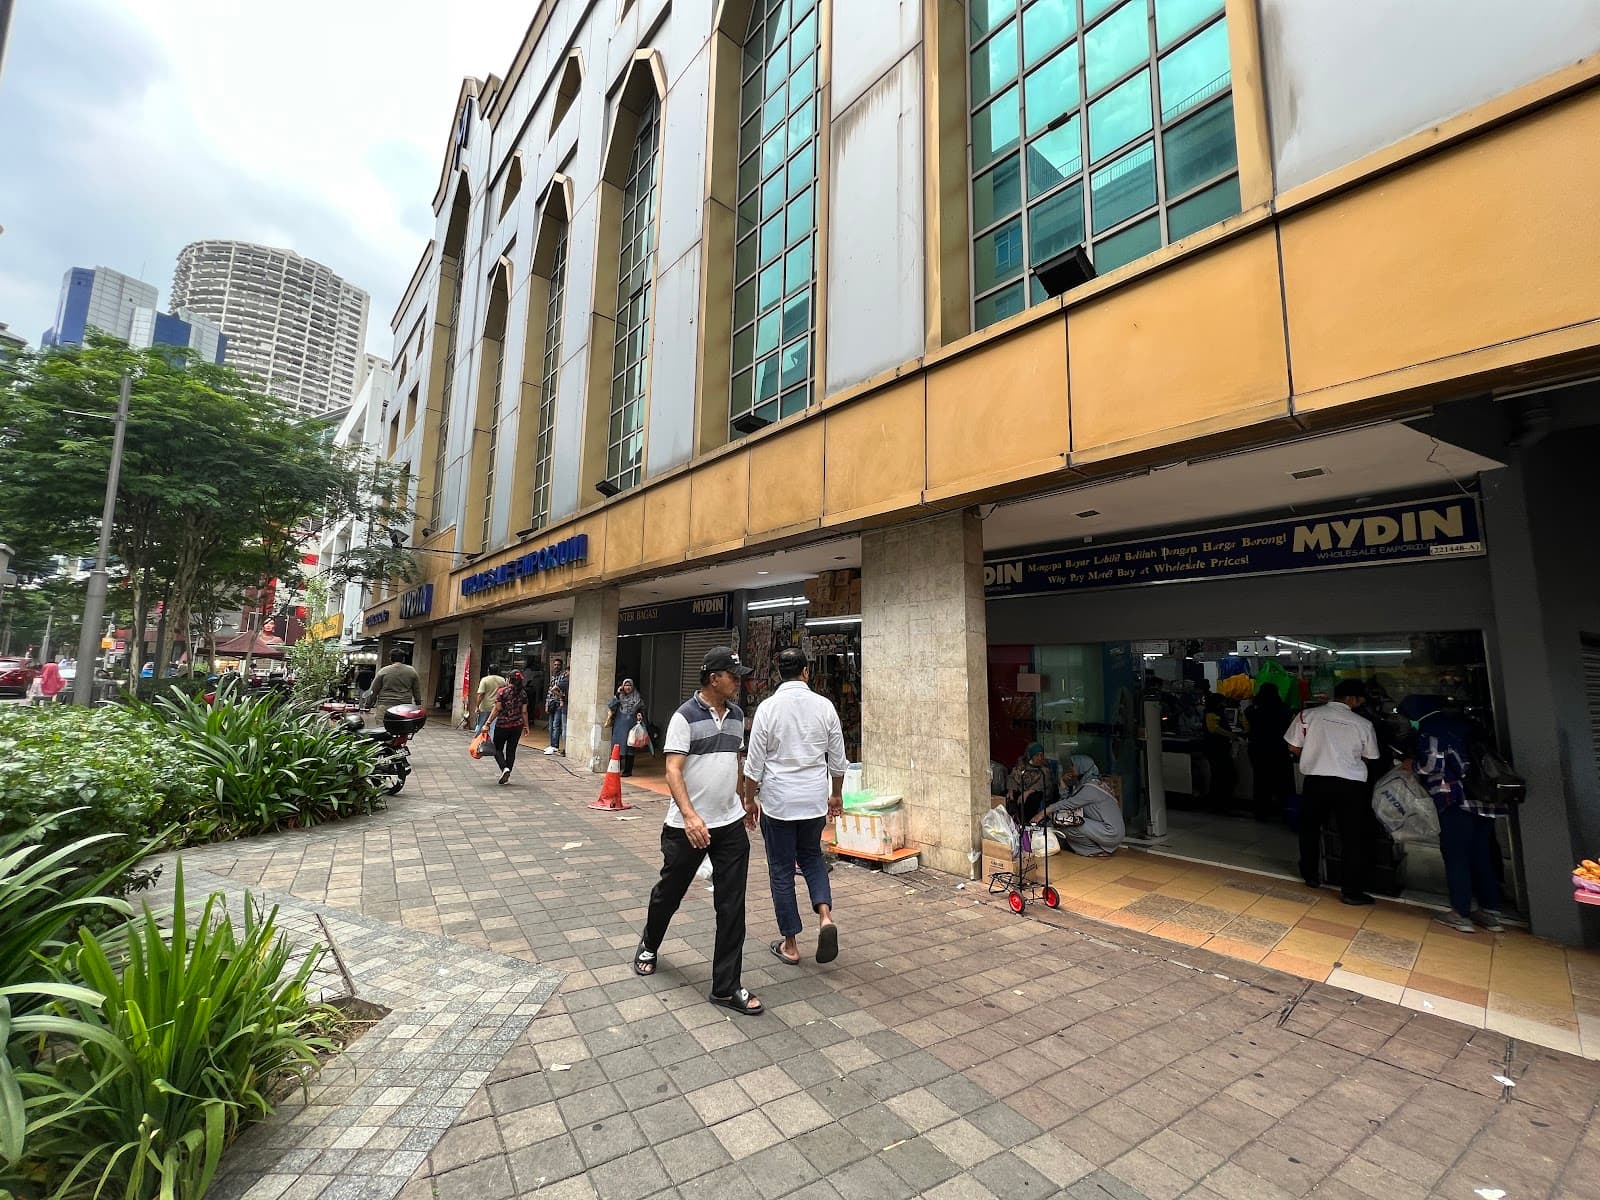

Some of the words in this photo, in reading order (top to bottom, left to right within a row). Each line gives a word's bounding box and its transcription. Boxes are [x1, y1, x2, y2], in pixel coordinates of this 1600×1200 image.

[1292, 505, 1464, 553] MYDIN
[1065, 558, 1090, 570] Bayar
[1125, 548, 1157, 561] Belilah
[1202, 541, 1237, 552] Harga
[1241, 532, 1287, 548] Borong!
[1316, 547, 1377, 560] WHOLESALE
[1048, 575, 1066, 585] Why
[1070, 573, 1085, 583] Pay
[1088, 569, 1113, 581] More?
[1117, 567, 1136, 577] Buy
[1154, 561, 1206, 574] Wholesale
[1210, 555, 1249, 568] Prices!
[692, 598, 725, 614] MYDIN
